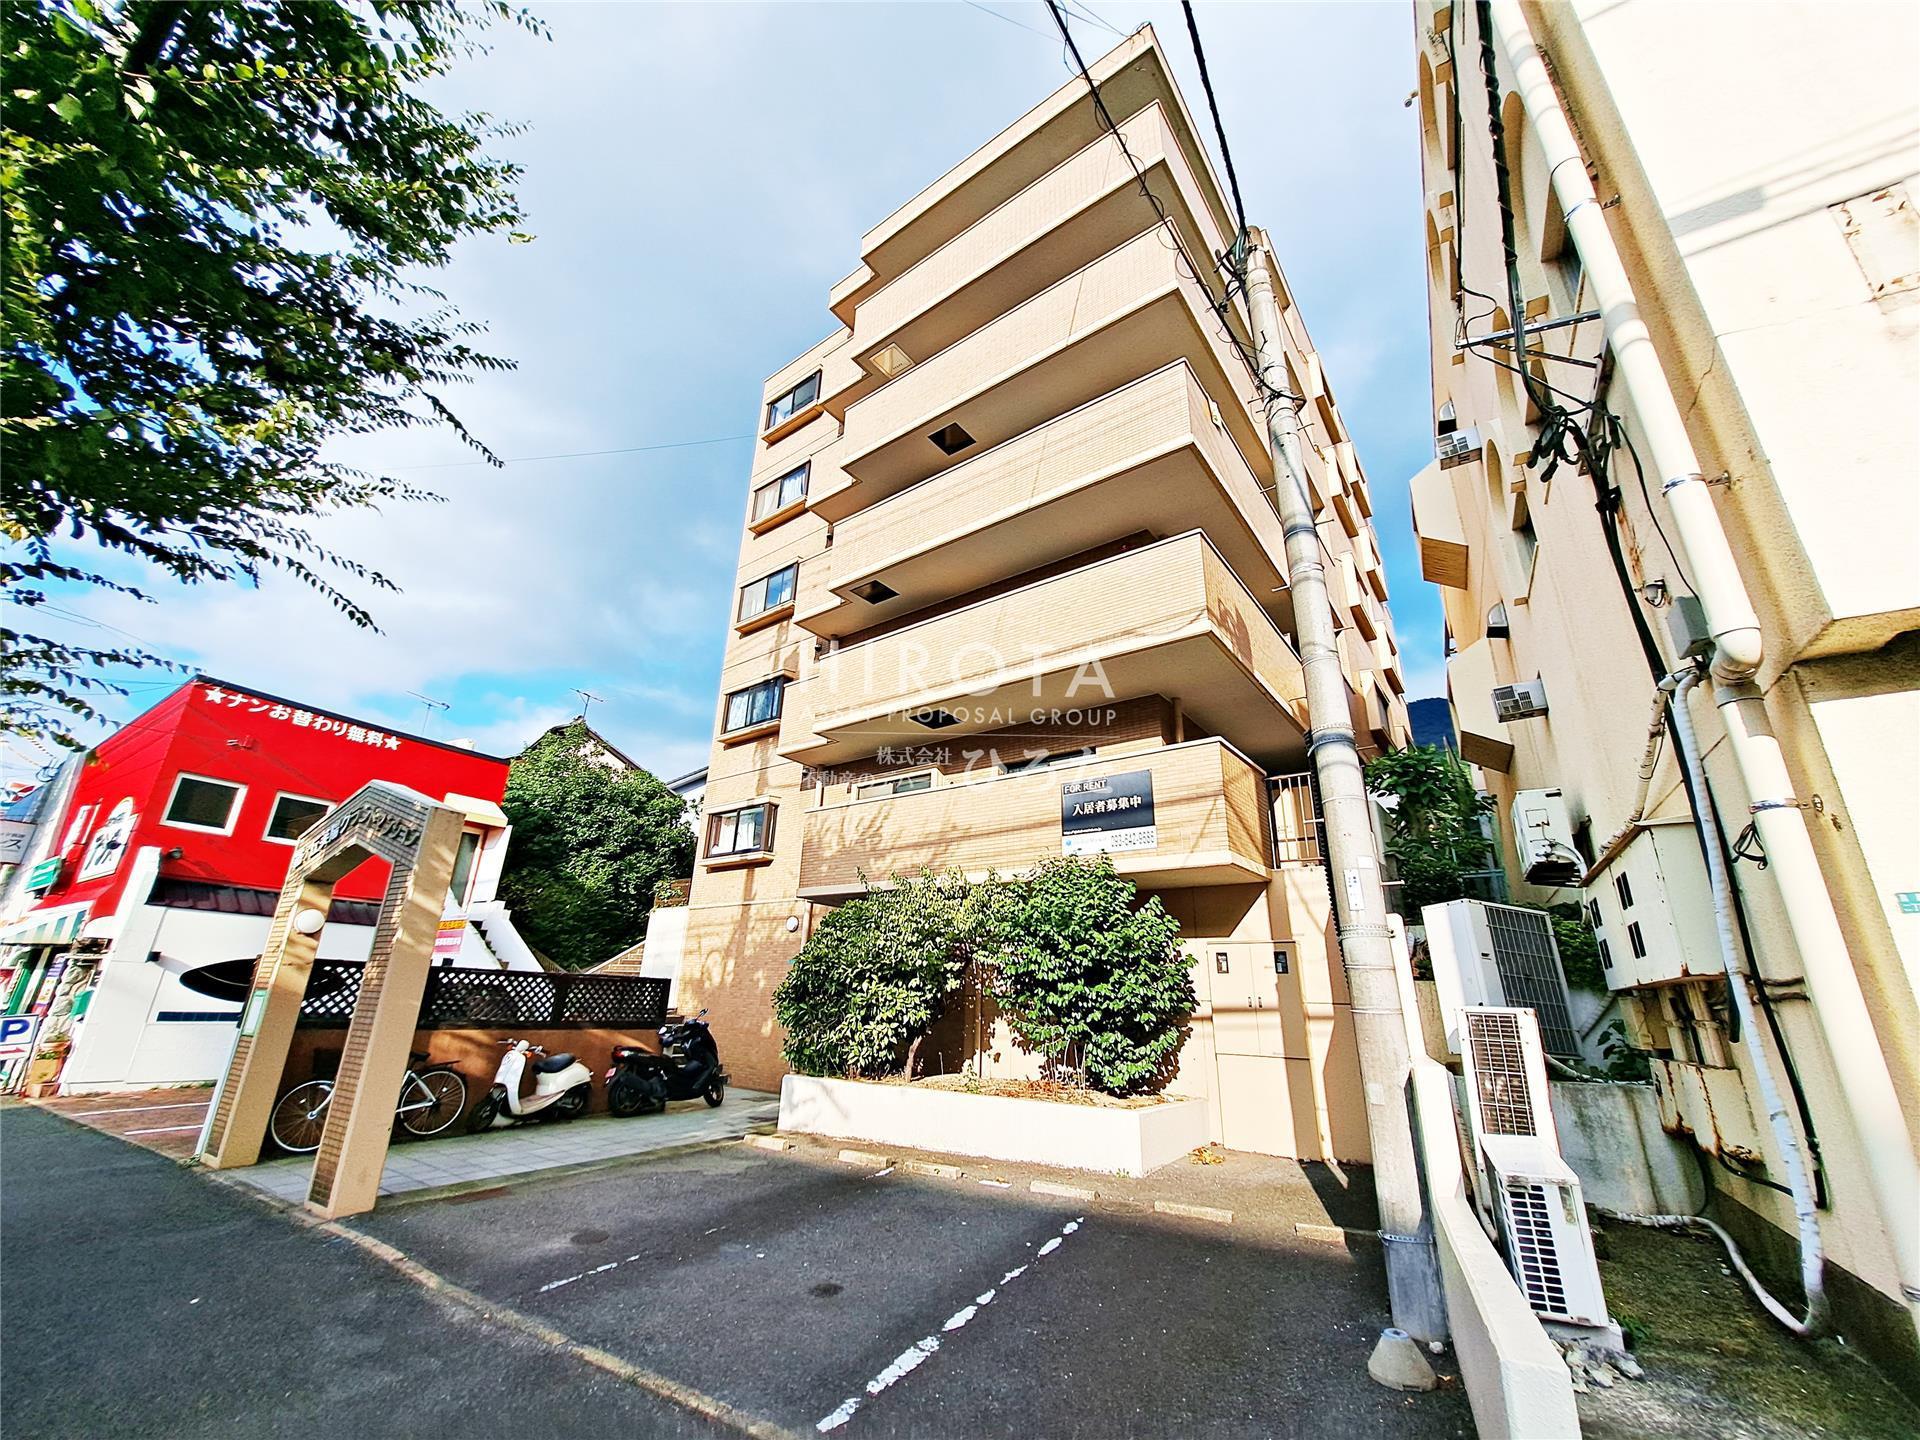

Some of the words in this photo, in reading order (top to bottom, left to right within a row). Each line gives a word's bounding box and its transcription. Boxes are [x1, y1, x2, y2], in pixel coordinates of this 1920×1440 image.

[226, 693, 384, 748] ナンお替わり無料
[1064, 784, 1082, 795] FOR
[1083, 779, 1107, 791] RENT
[1072, 795, 1142, 817] 入居者募集中
[0, 1019, 31, 1043] P
